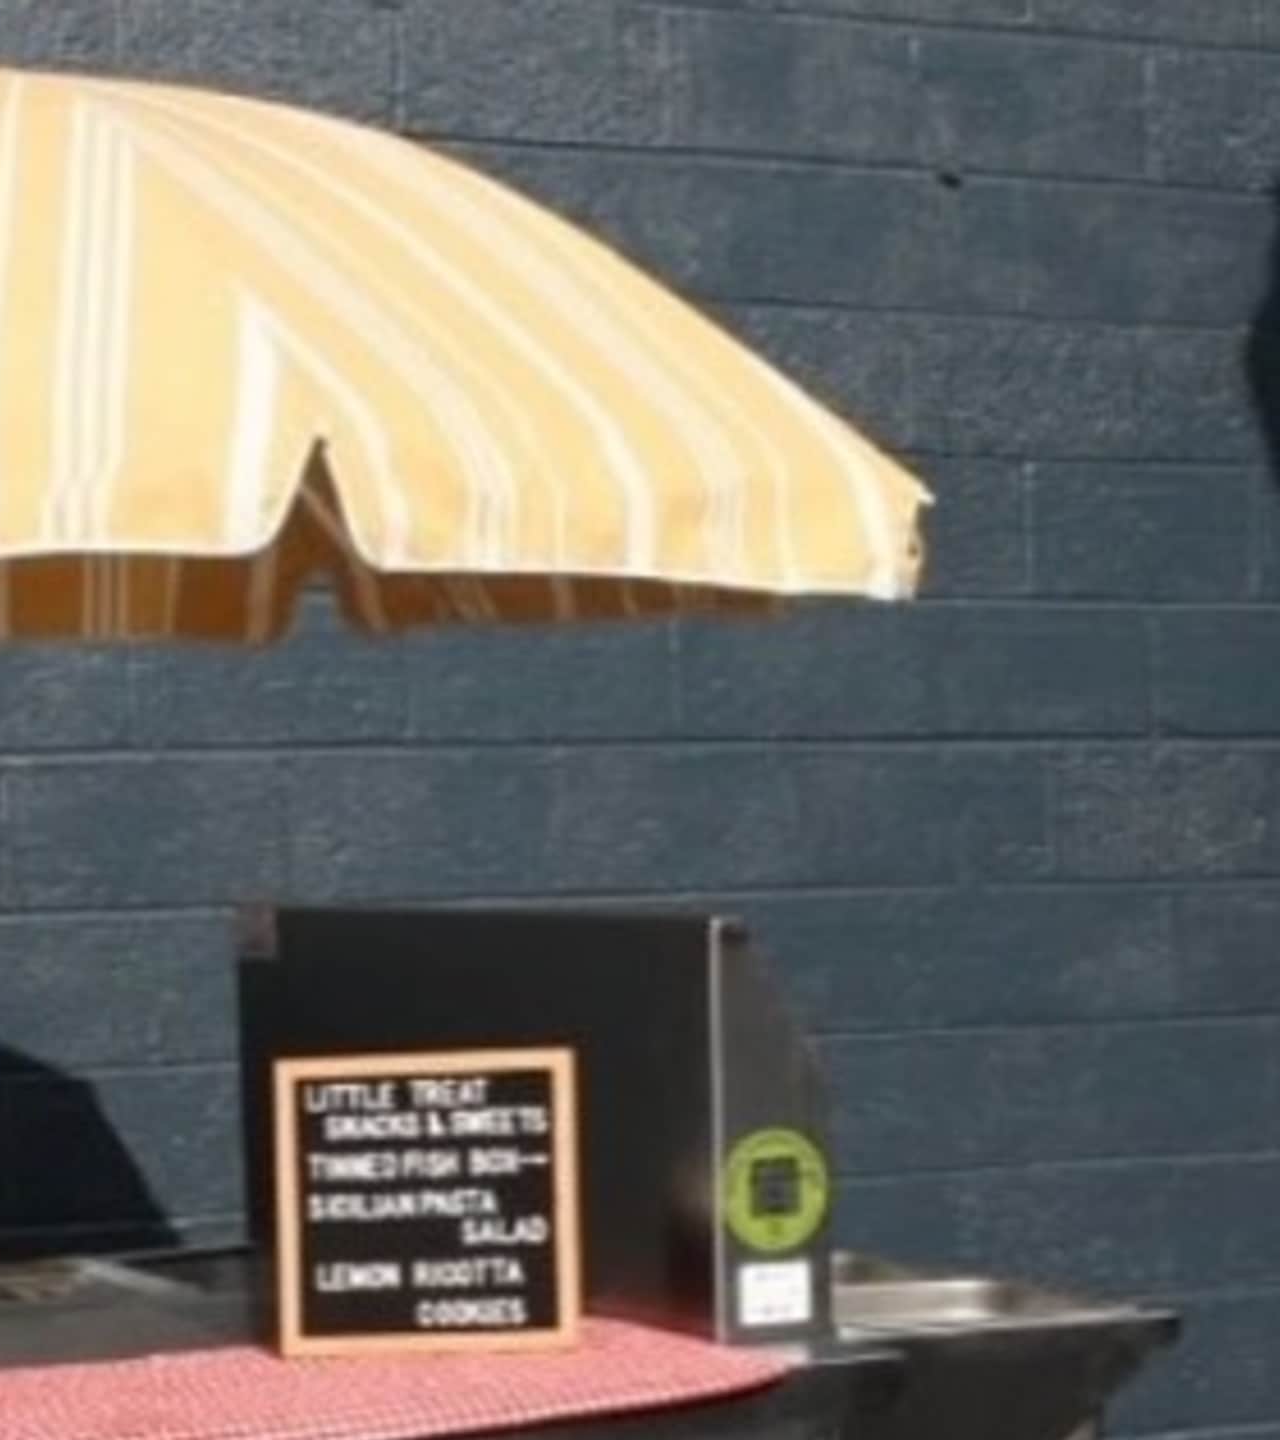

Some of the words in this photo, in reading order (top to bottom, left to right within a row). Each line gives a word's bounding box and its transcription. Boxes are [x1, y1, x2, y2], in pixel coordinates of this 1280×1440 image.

[306, 1084, 395, 1114] LITTLE
[411, 1080, 488, 1106] TREAT
[325, 1112, 421, 1141] SNACKS
[451, 1106, 548, 1137] SWEETS
[308, 1153, 397, 1181] TINNED
[403, 1151, 459, 1178] FISH
[419, 1189, 496, 1215] PASTA
[462, 1214, 549, 1245] SALAD
[316, 1264, 401, 1291] LEMON
[413, 1258, 524, 1286] RICOTTA
[417, 1298, 527, 1326] COOKIES
